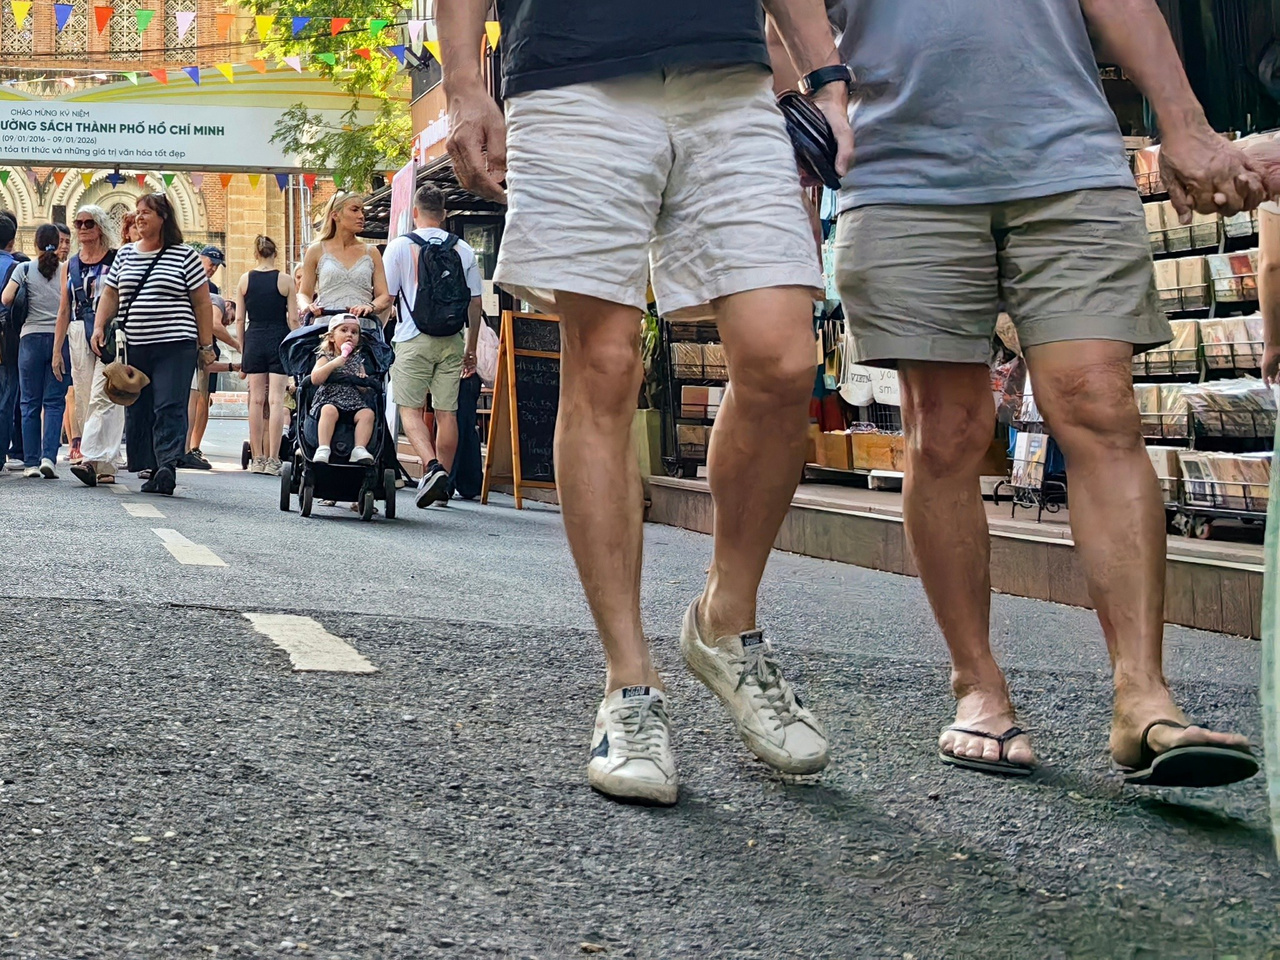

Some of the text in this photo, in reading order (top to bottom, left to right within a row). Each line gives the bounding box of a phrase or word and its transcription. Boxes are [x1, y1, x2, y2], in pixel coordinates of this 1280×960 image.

[10, 107, 33, 116] CHÀO
[72, 108, 90, 119] NIỆM
[39, 119, 73, 132] SÁCH
[76, 120, 117, 133] THÀNH
[119, 120, 146, 134] PHỐ
[148, 121, 167, 135] HỒ
[169, 122, 191, 136] CHÍ
[193, 125, 225, 136] MINH
[2, 134, 46, 144] (09/01/2016
[52, 135, 97, 144] 09/01/2026)
[21, 144, 30, 154] tri
[31, 145, 51, 155] thức
[64, 147, 91, 157] những
[92, 147, 106, 157] giá
[108, 148, 117, 158] trị
[118, 148, 134, 157] văn
[136, 149, 153, 158] hóa
[154, 148, 167, 158] tốt
[169, 149, 186, 158] đẹp
